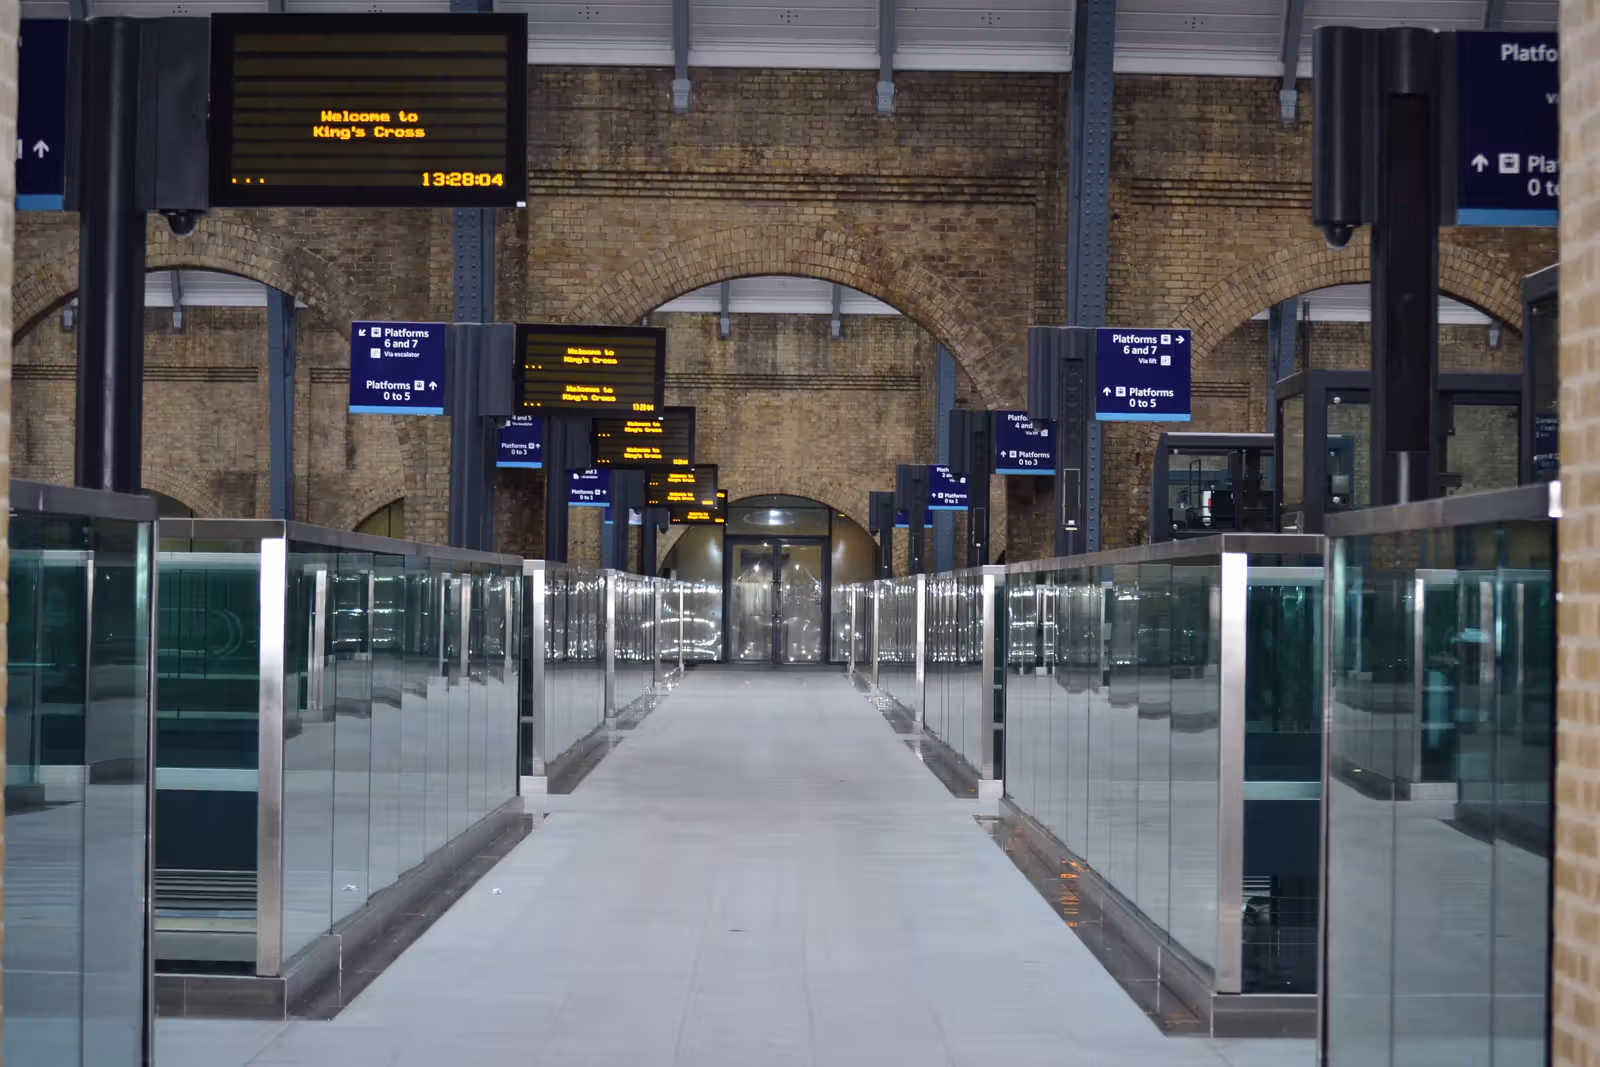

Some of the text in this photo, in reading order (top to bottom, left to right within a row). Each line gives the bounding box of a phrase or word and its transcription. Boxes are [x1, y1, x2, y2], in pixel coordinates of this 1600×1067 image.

[1501, 43, 1559, 62] Platfo
[321, 110, 418, 123] Welcome to
[313, 126, 425, 139] King's Cross
[422, 172, 504, 187] 13:28:04
[1528, 178, 1540, 196] 0
[384, 328, 429, 338] Platforms
[384, 339, 418, 348] 6 and 7
[1112, 334, 1158, 344] Platforms
[1123, 345, 1158, 355] 6 and 7
[366, 380, 411, 390] Platforms
[383, 391, 411, 401] 0 to 5
[1129, 387, 1174, 397] Platforms
[1129, 398, 1157, 408] 0 to 5
[1018, 451, 1050, 459] Platforms
[1018, 458, 1038, 466] 0 to 3
